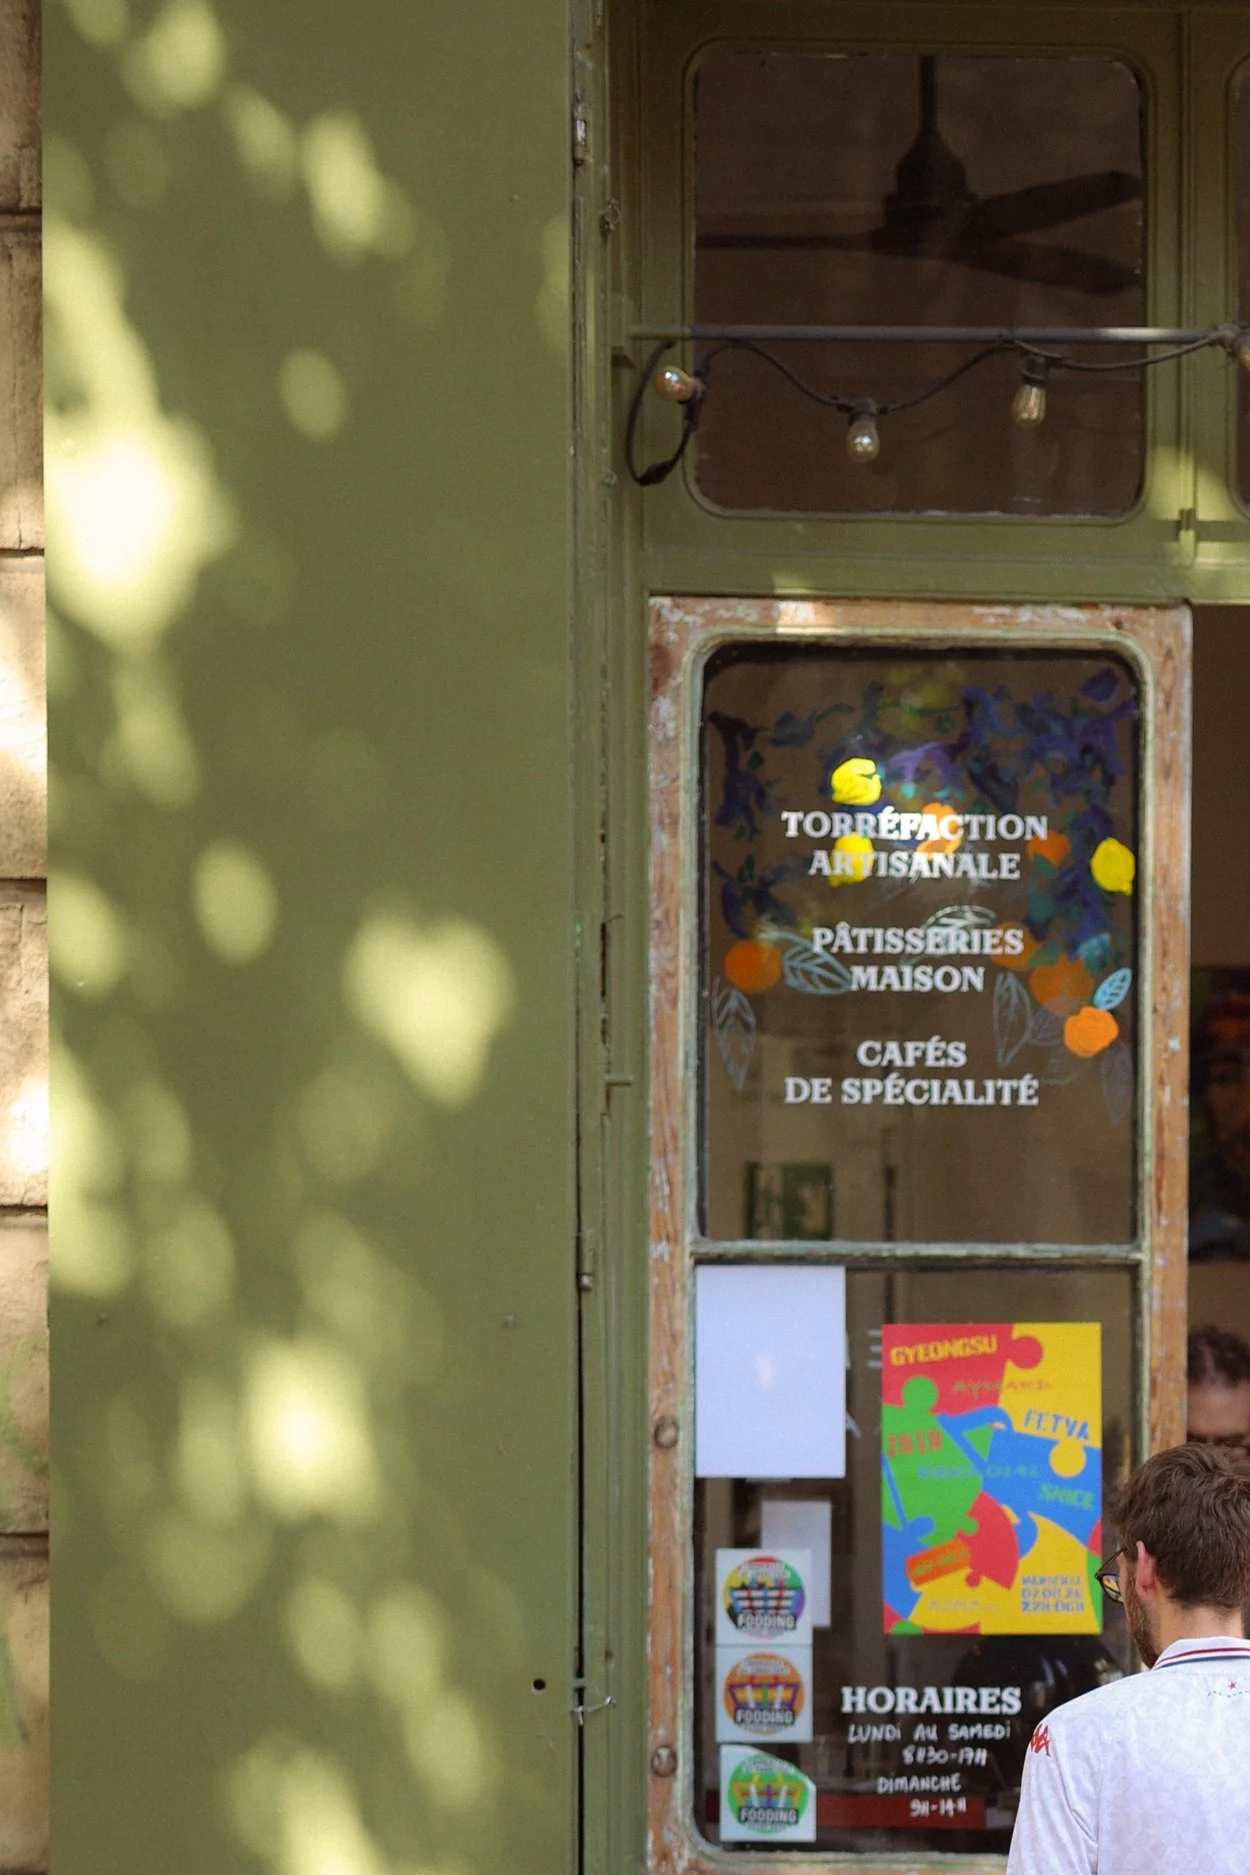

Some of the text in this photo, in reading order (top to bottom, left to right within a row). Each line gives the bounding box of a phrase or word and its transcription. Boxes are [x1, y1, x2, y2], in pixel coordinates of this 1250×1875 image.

[781, 806, 1048, 841] TORRÉFACTION
[808, 850, 1021, 880] ARTISANALE
[813, 921, 1025, 955] PÂTISSERIES
[850, 965, 985, 993] MAISON
[856, 1035, 968, 1068] CAFÉS
[784, 1072, 1040, 1106] DE SPÉCIALITÉ
[841, 1685, 1022, 1716] HORAIRES
[735, 1710, 794, 1724] FOODING
[913, 1723, 938, 1742] AU
[740, 1808, 798, 1822] FOODING
